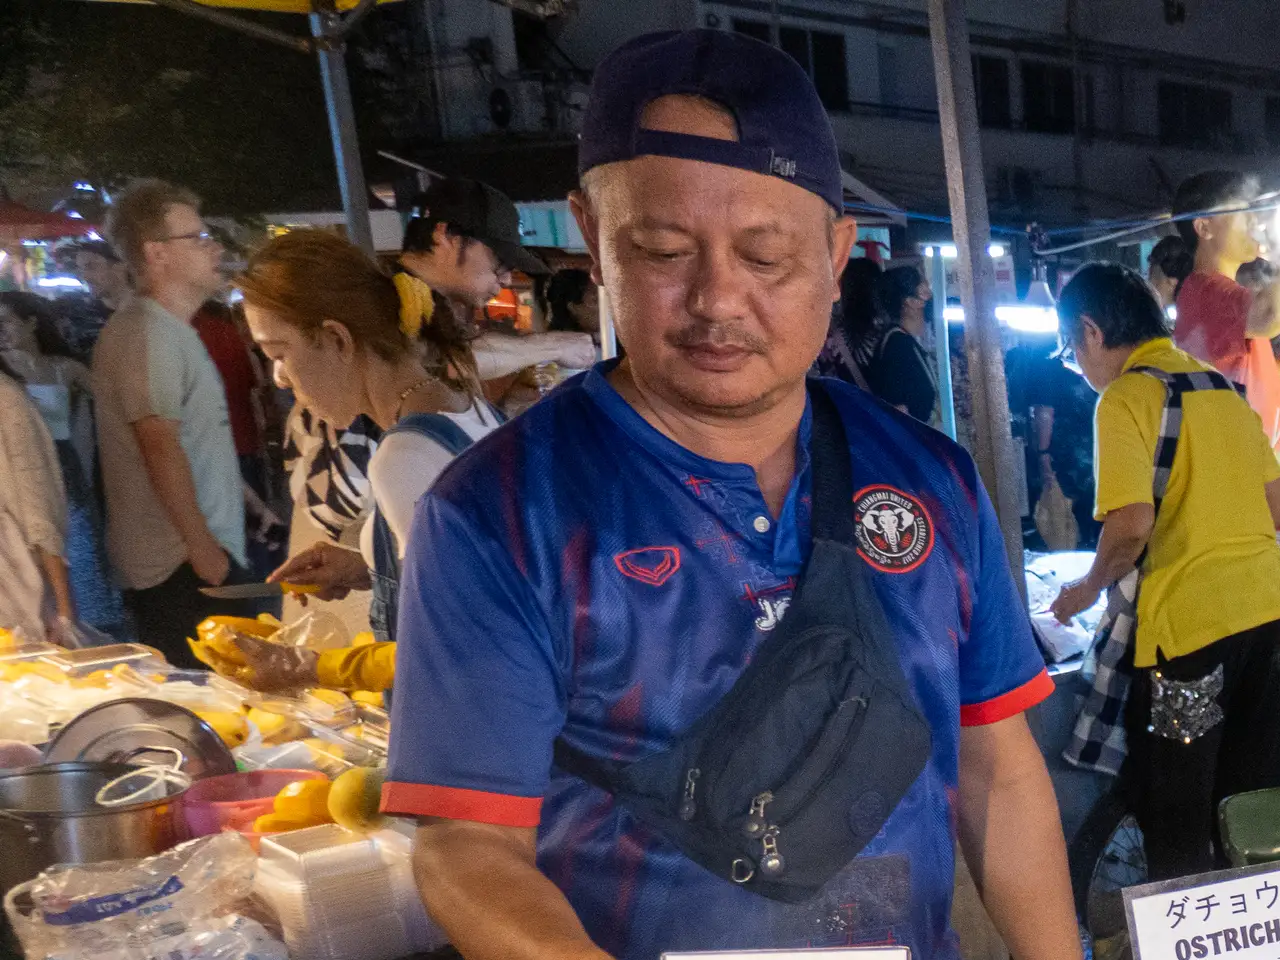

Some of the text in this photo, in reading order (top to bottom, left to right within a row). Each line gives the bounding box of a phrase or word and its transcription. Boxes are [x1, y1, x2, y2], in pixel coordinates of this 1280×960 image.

[857, 491, 913, 513] CHIANGMAI UNITED
[1166, 881, 1280, 929] ダチョウ
